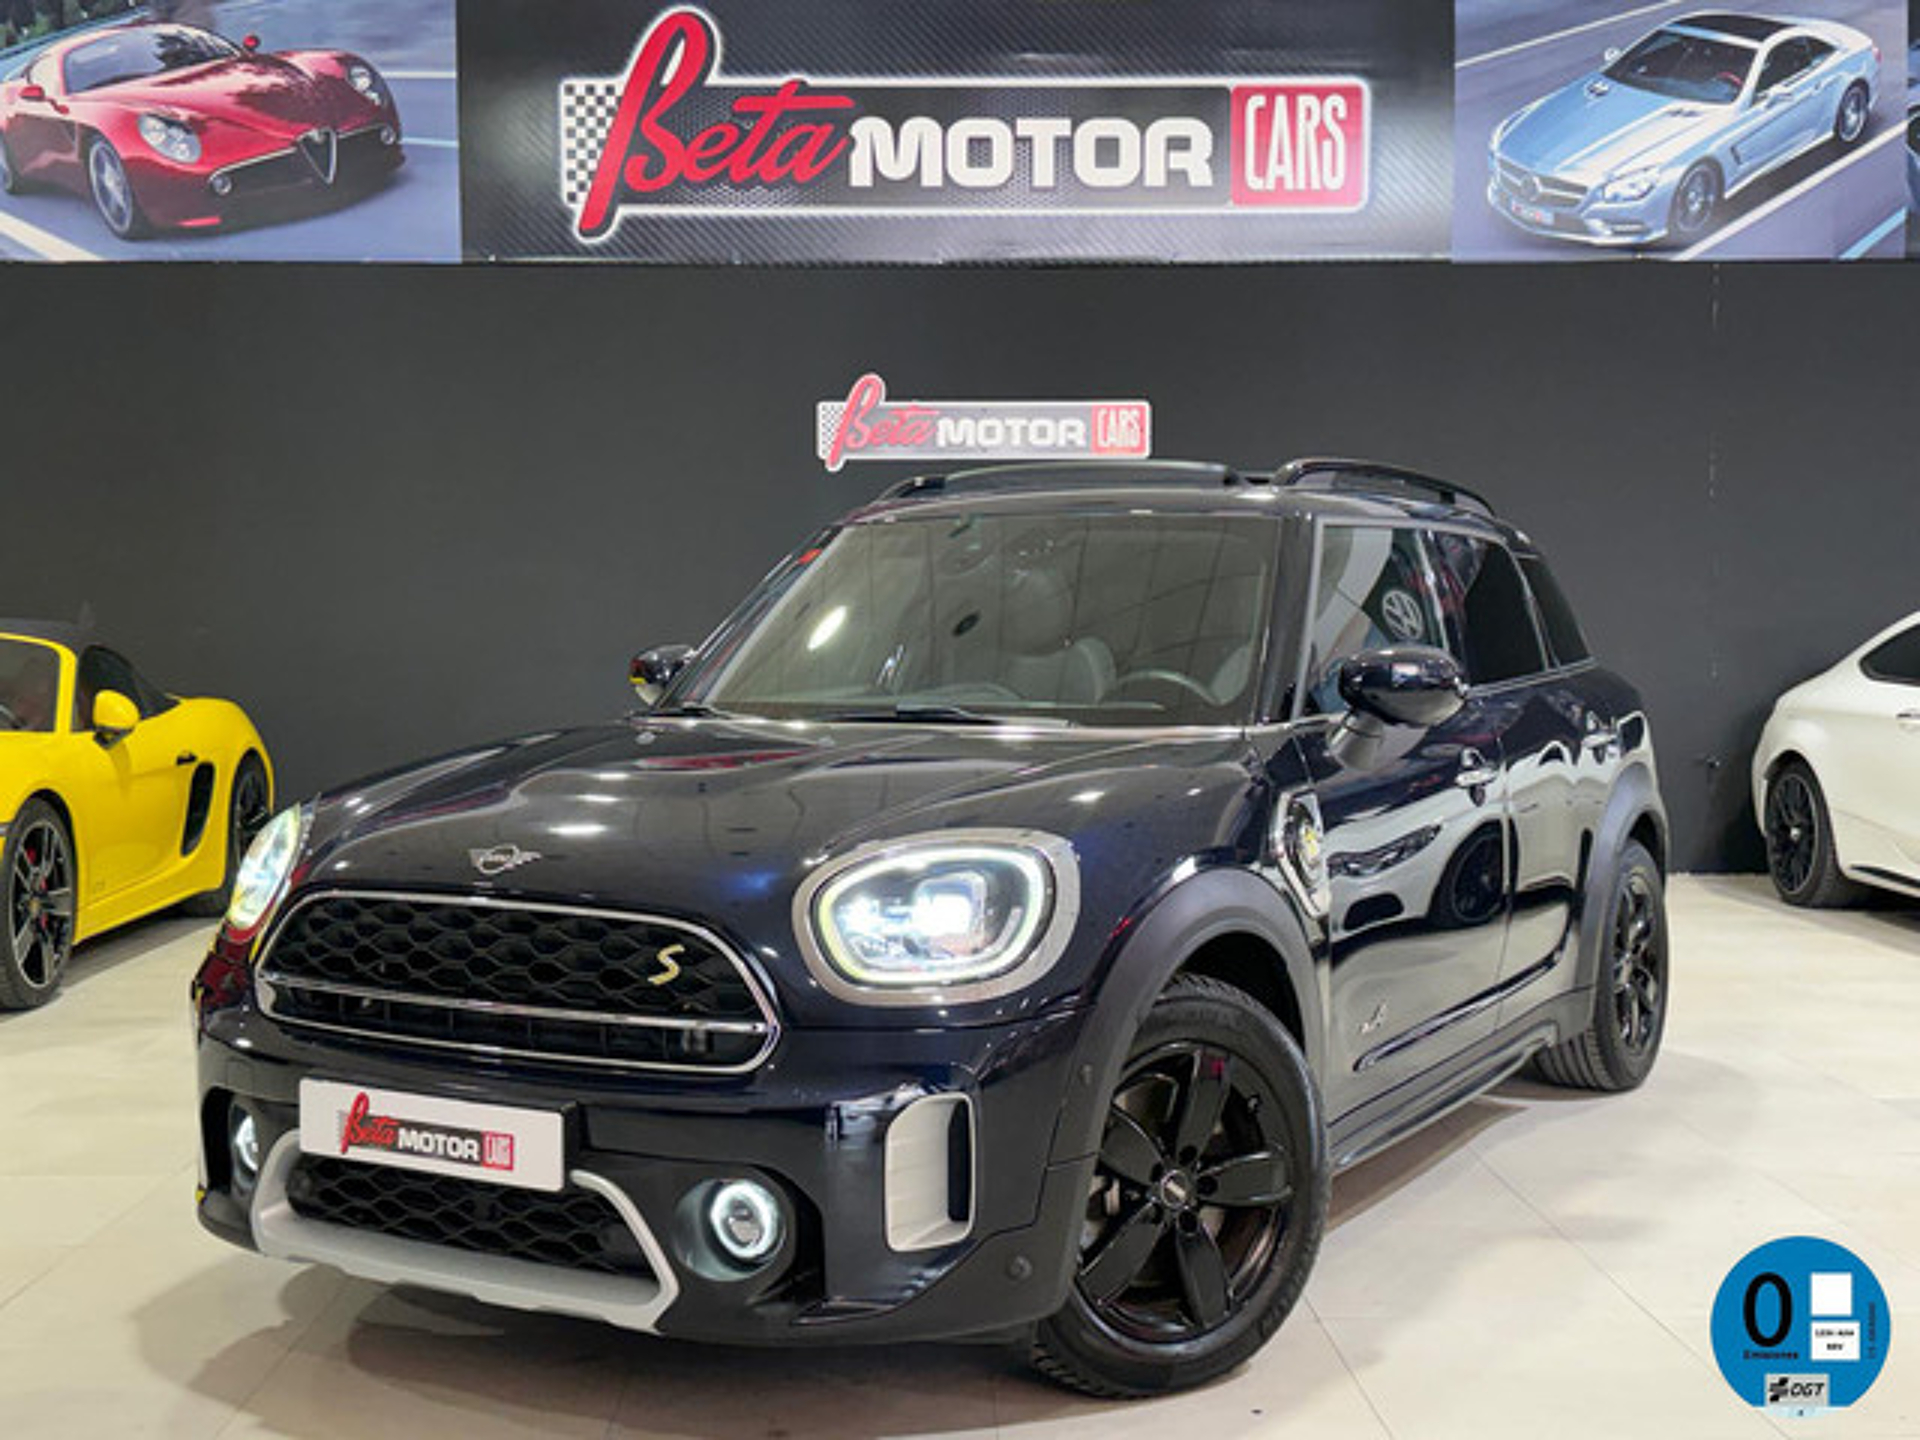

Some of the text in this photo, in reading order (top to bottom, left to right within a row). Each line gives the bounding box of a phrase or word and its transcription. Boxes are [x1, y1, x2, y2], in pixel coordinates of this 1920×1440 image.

[579, 11, 1349, 231] Beta MOTOR CARS
[936, 417, 1087, 448] MOTOR
[1097, 407, 1142, 449] CARS
[647, 944, 684, 986] S
[398, 1127, 481, 1161] MOTOR
